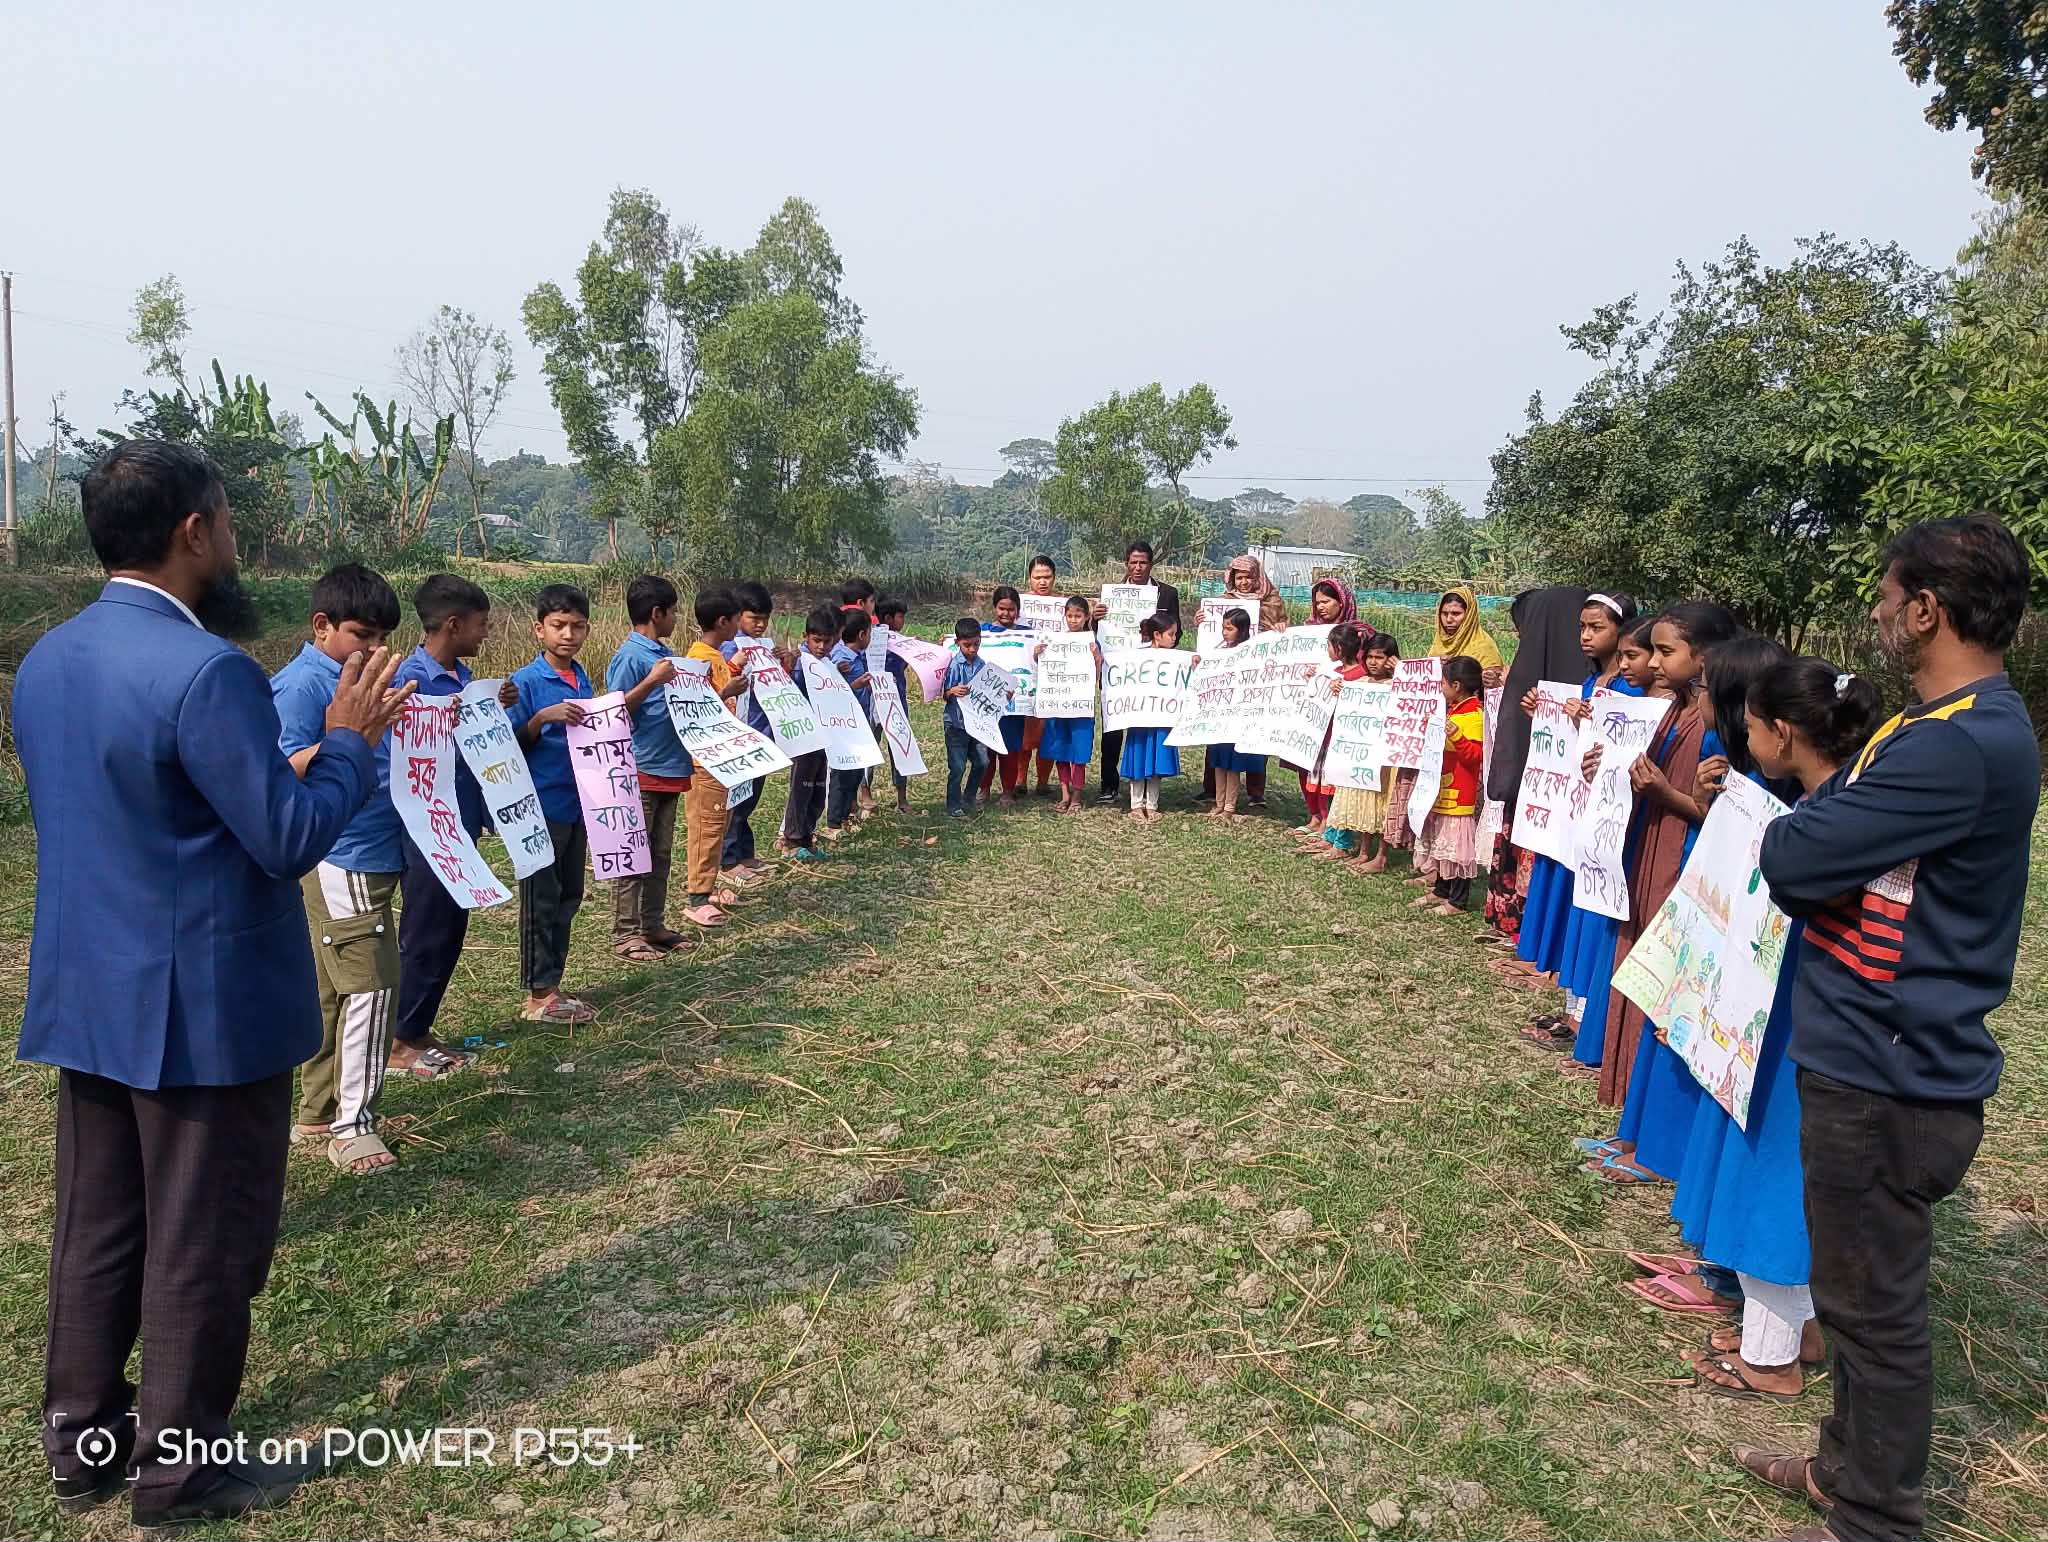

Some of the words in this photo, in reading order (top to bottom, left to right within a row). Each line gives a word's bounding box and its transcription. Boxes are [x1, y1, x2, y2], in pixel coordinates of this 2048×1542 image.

[808, 662, 850, 693] Save
[981, 669, 1008, 699] SAVE
[1107, 659, 1192, 689] GREEN
[817, 703, 858, 729] Land
[596, 843, 636, 873] চাই
